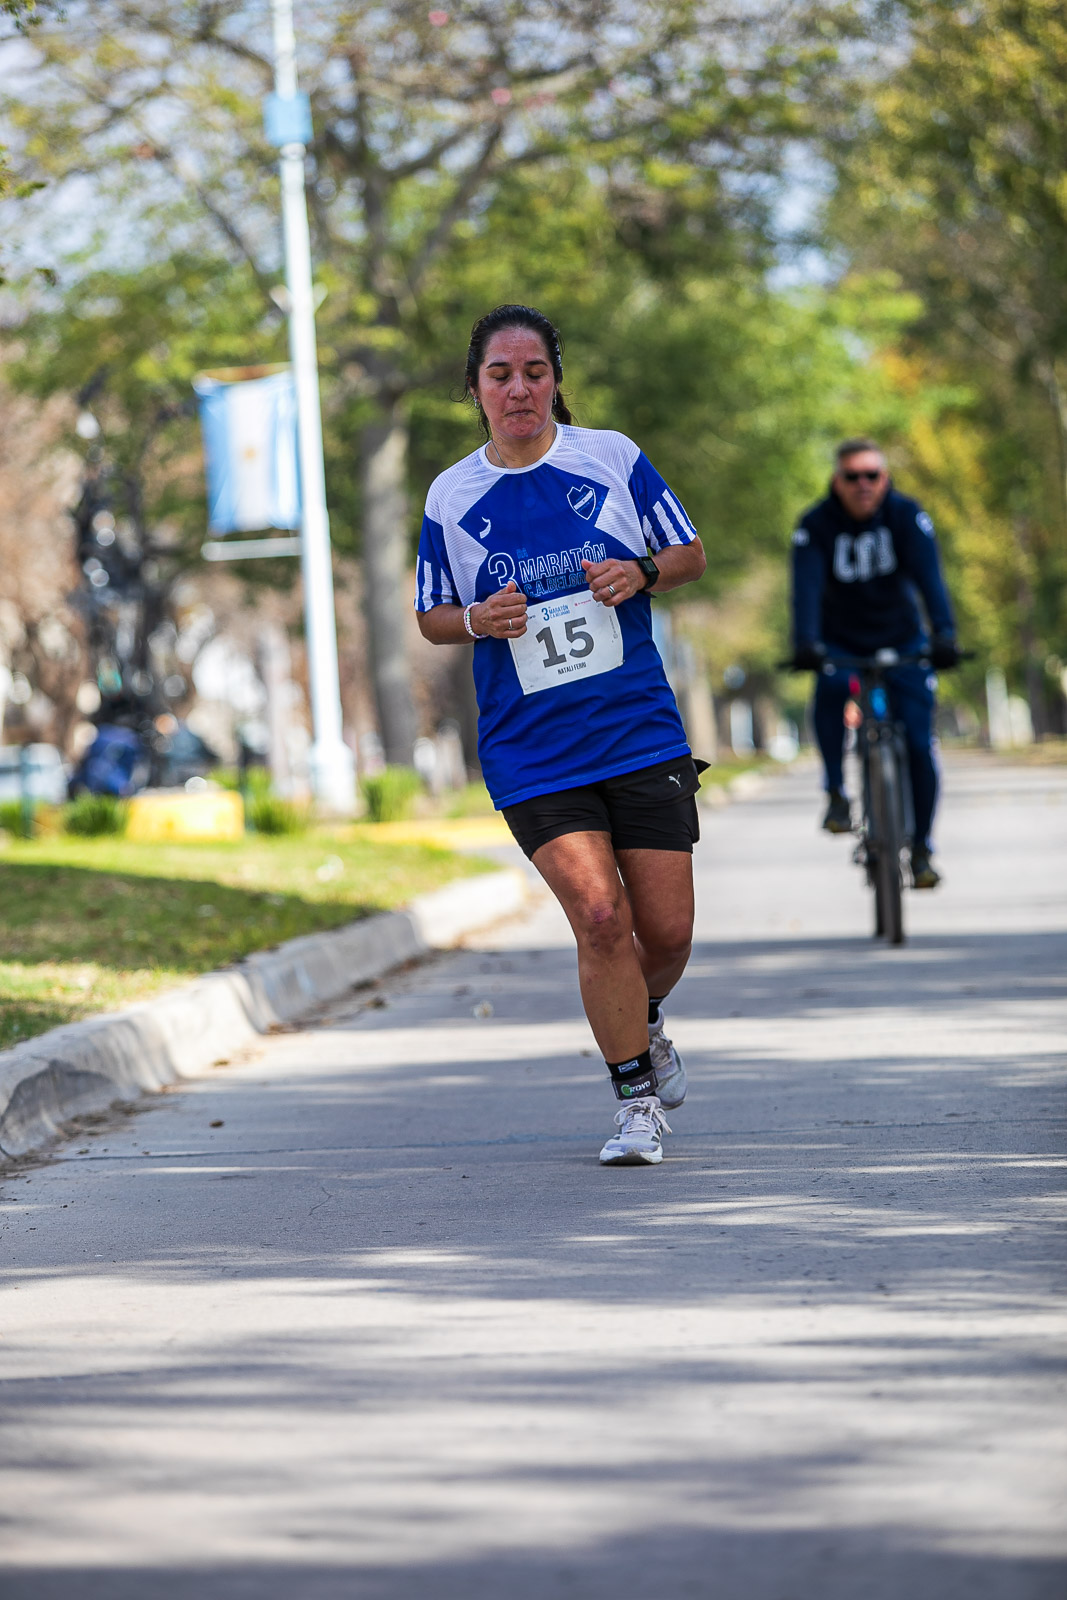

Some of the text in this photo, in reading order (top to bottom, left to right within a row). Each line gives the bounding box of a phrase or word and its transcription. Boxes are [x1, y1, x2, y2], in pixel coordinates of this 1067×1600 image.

[519, 541, 607, 584] MARATÓN
[541, 607, 550, 621] 3
[535, 616, 595, 668] 15
